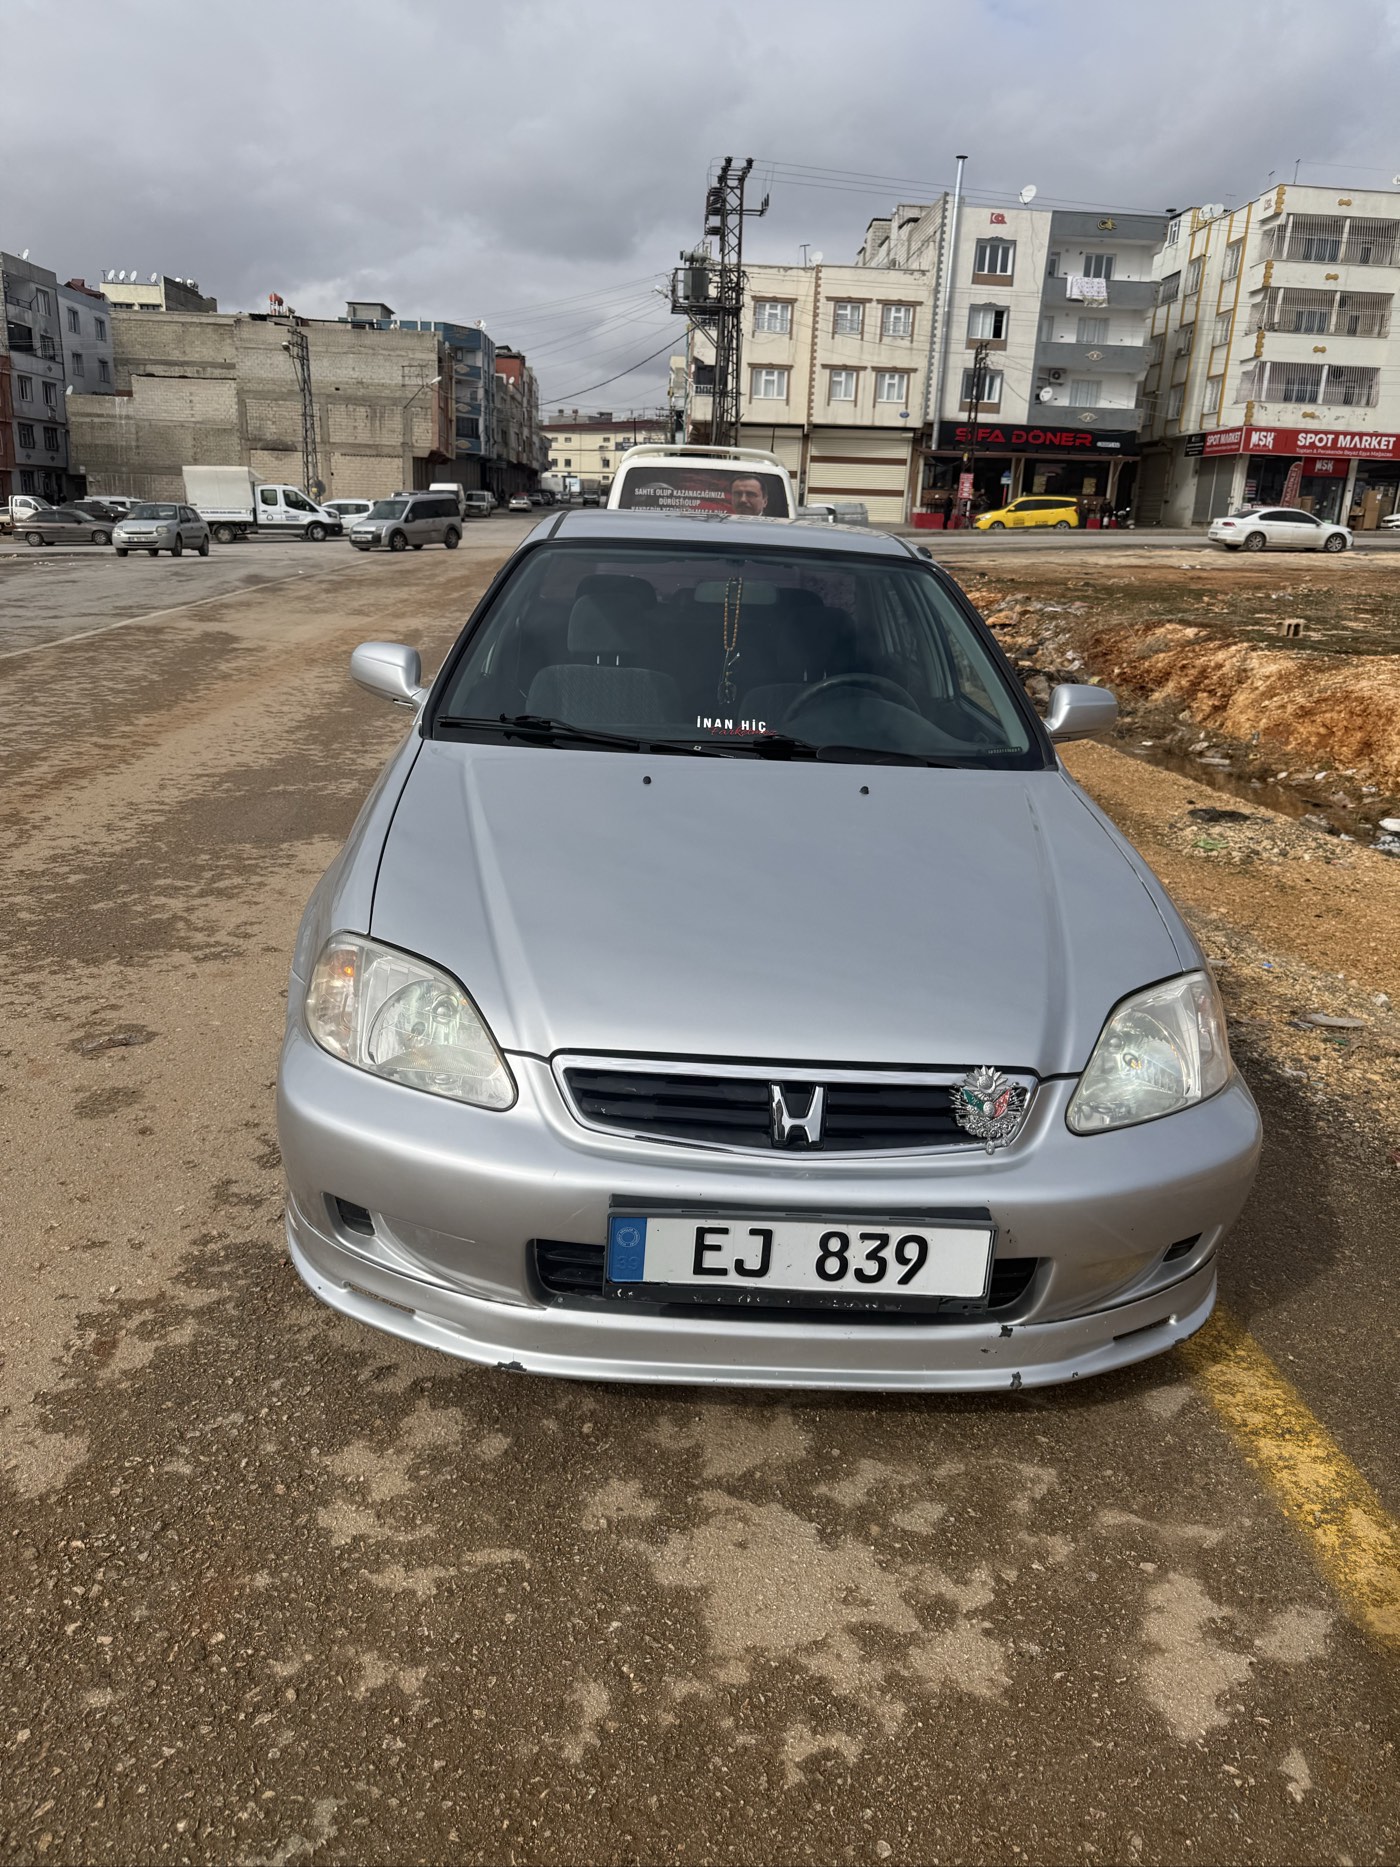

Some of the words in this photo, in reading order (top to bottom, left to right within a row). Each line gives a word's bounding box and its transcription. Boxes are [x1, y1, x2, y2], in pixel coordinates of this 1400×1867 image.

[1011, 429, 1093, 447] DÖNER
[1206, 434, 1220, 446] SPOT
[1220, 431, 1241, 444] MARKET
[1249, 431, 1275, 449] MSK
[1297, 432, 1335, 447] SPOT
[1337, 434, 1396, 450] MARKET
[634, 488, 654, 496] SAHTE
[655, 488, 671, 496] OLUP
[673, 489, 725, 499] KAZANACAĞINIZA
[658, 497, 684, 506] DÜRÜST
[684, 499, 701, 507] OLUP
[697, 715, 733, 730] İNAN
[741, 718, 766, 734] HİÇ
[692, 1226, 774, 1278] EJ
[815, 1231, 929, 1286] 839
